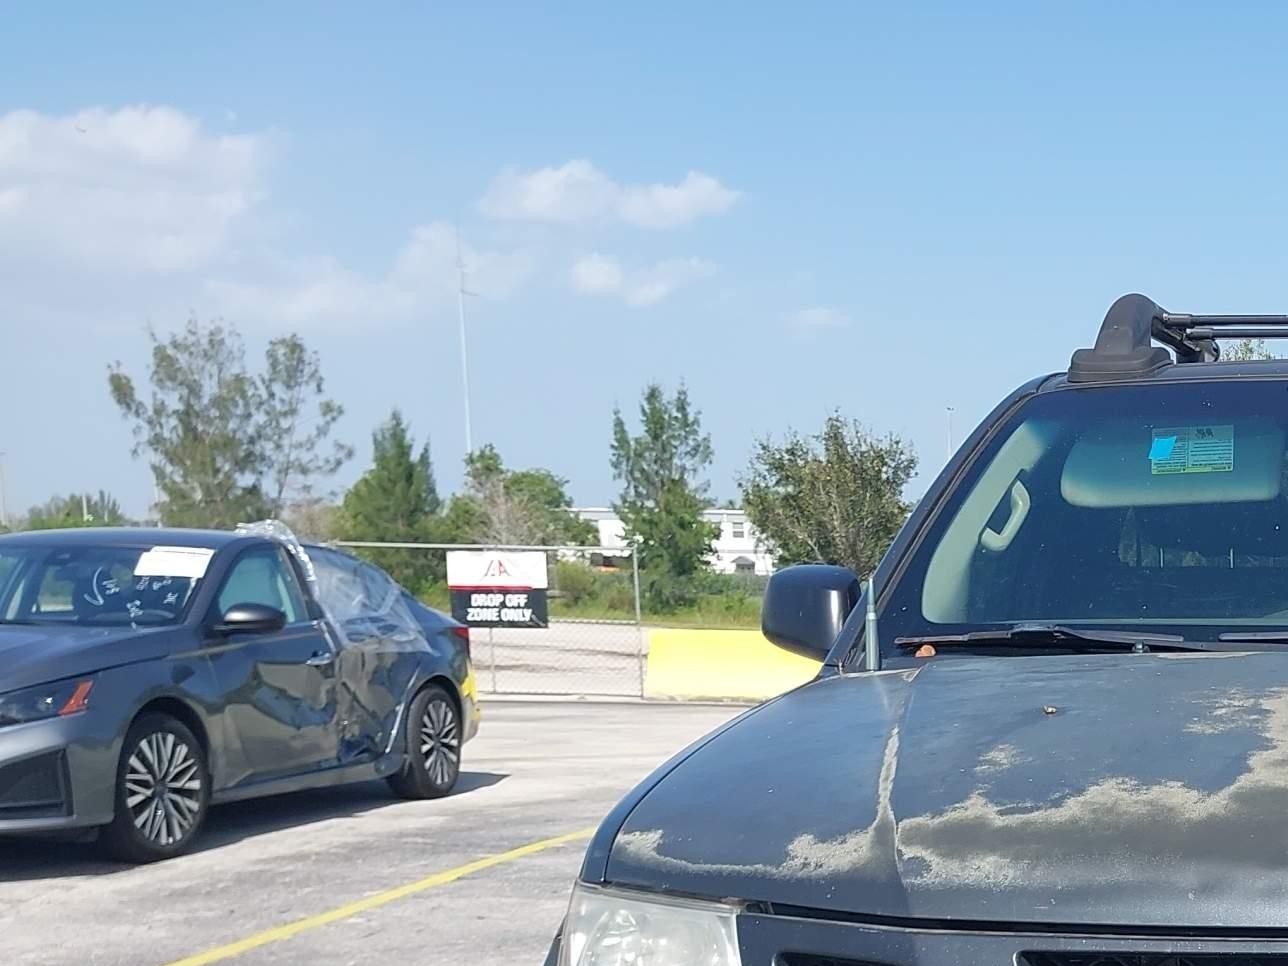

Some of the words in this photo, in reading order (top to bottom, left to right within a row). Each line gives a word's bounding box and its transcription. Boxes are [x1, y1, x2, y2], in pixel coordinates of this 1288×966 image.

[470, 594, 504, 607] DROP
[505, 594, 528, 607] OFF
[466, 608, 500, 621] ZONE
[500, 608, 532, 621] ONLY
